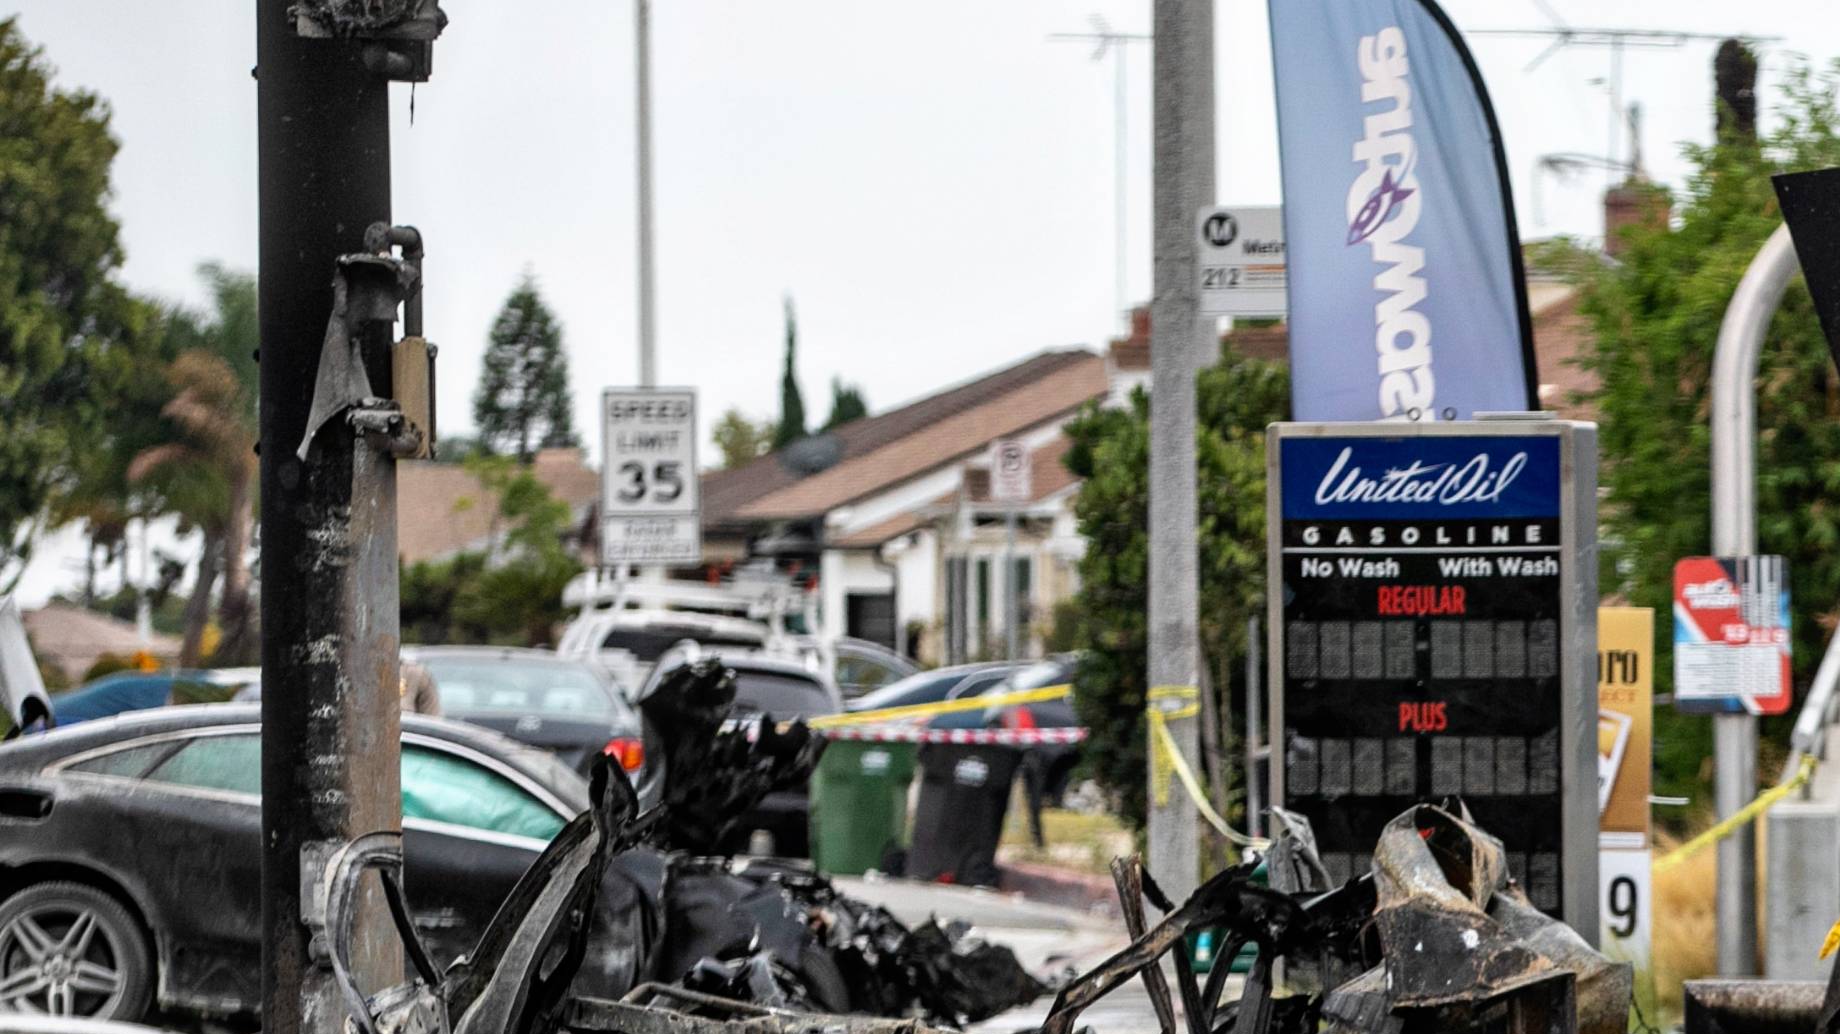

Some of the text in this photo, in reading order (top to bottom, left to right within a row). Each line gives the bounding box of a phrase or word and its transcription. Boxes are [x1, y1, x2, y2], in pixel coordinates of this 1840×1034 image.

[1202, 267, 1240, 287] 212
[611, 400, 689, 423] SPEED
[616, 430, 681, 453] LIMIT
[617, 460, 684, 503] 35
[1314, 446, 1528, 505] United Oil
[1302, 525, 1542, 545] GASOLINE
[1301, 557, 1400, 578] No Wash
[1438, 556, 1559, 578] With Wash
[1378, 586, 1466, 614] REGULAR
[1399, 702, 1447, 732] PLUS
[1609, 876, 1638, 938] 9
